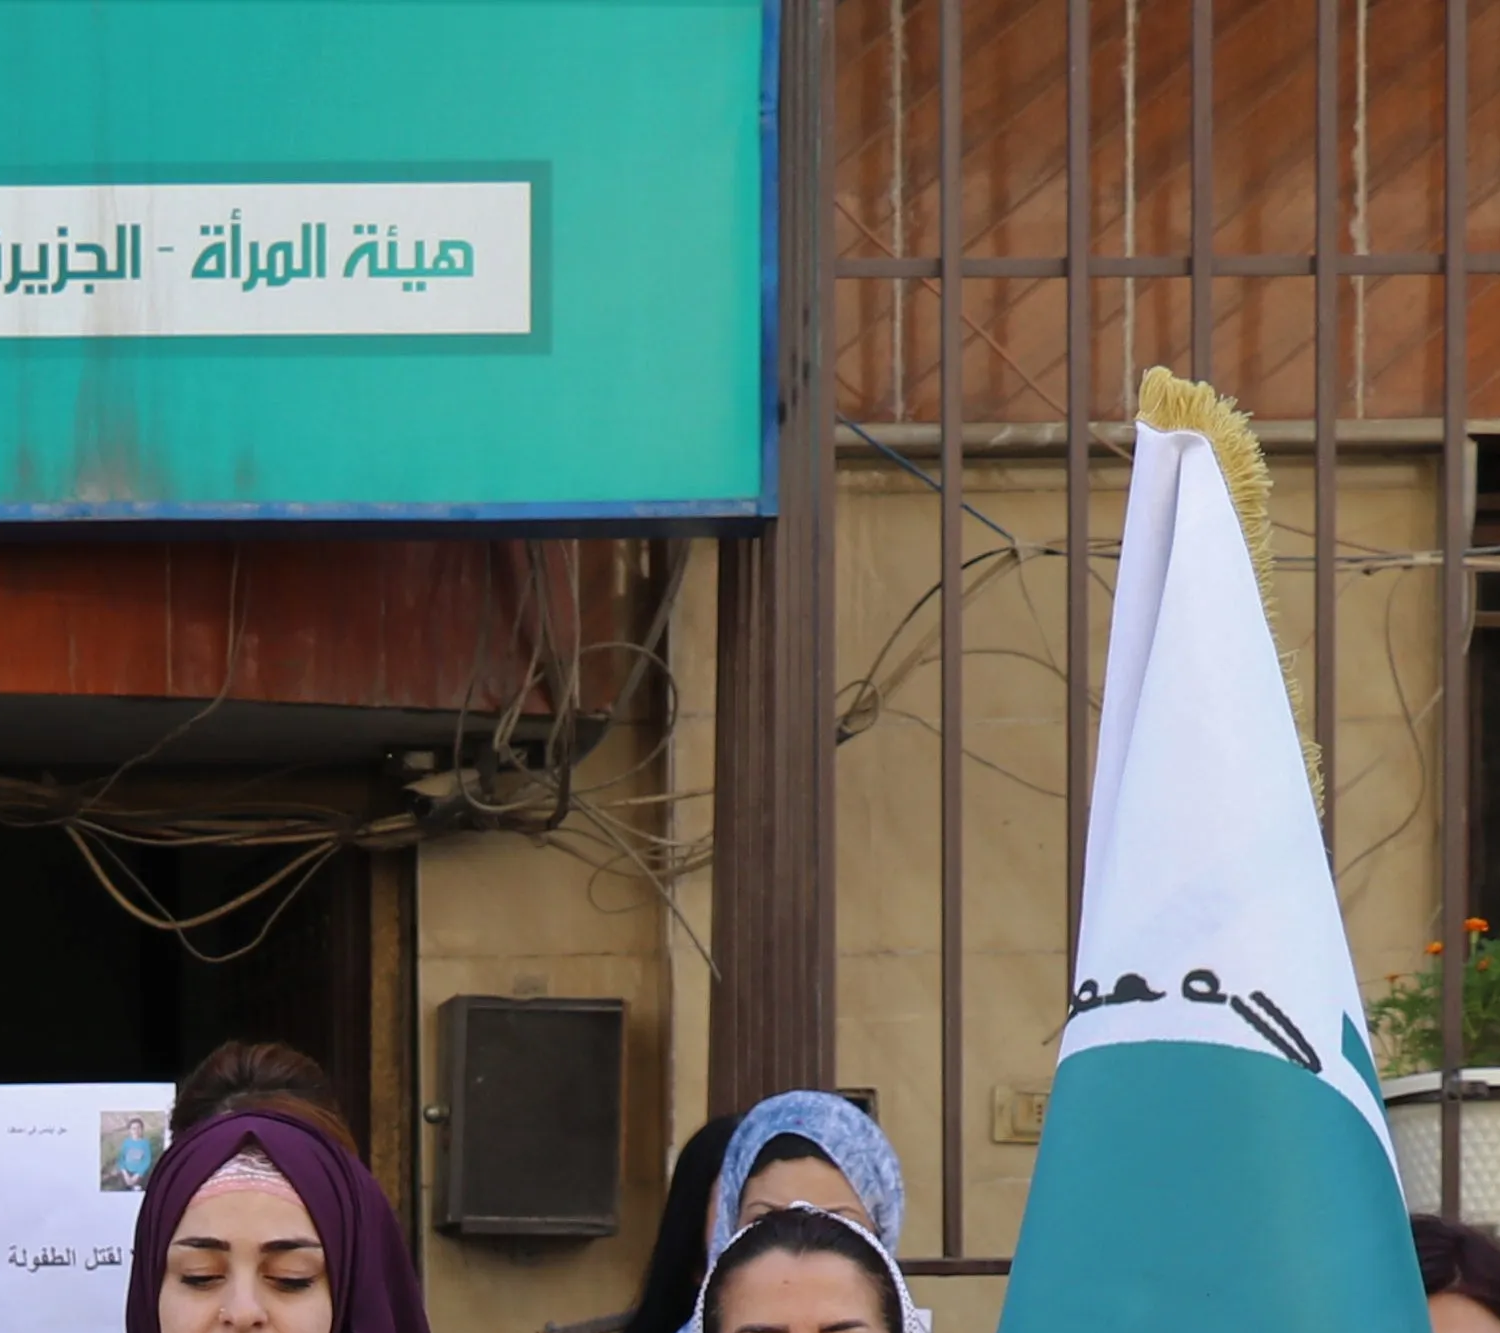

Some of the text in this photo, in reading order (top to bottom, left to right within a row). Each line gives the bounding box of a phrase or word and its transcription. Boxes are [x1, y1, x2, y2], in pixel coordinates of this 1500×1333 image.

[191, 209, 326, 292] المرأة
[342, 224, 474, 292] هيئة
[8, 1244, 122, 1273] لقتل الطفولة
